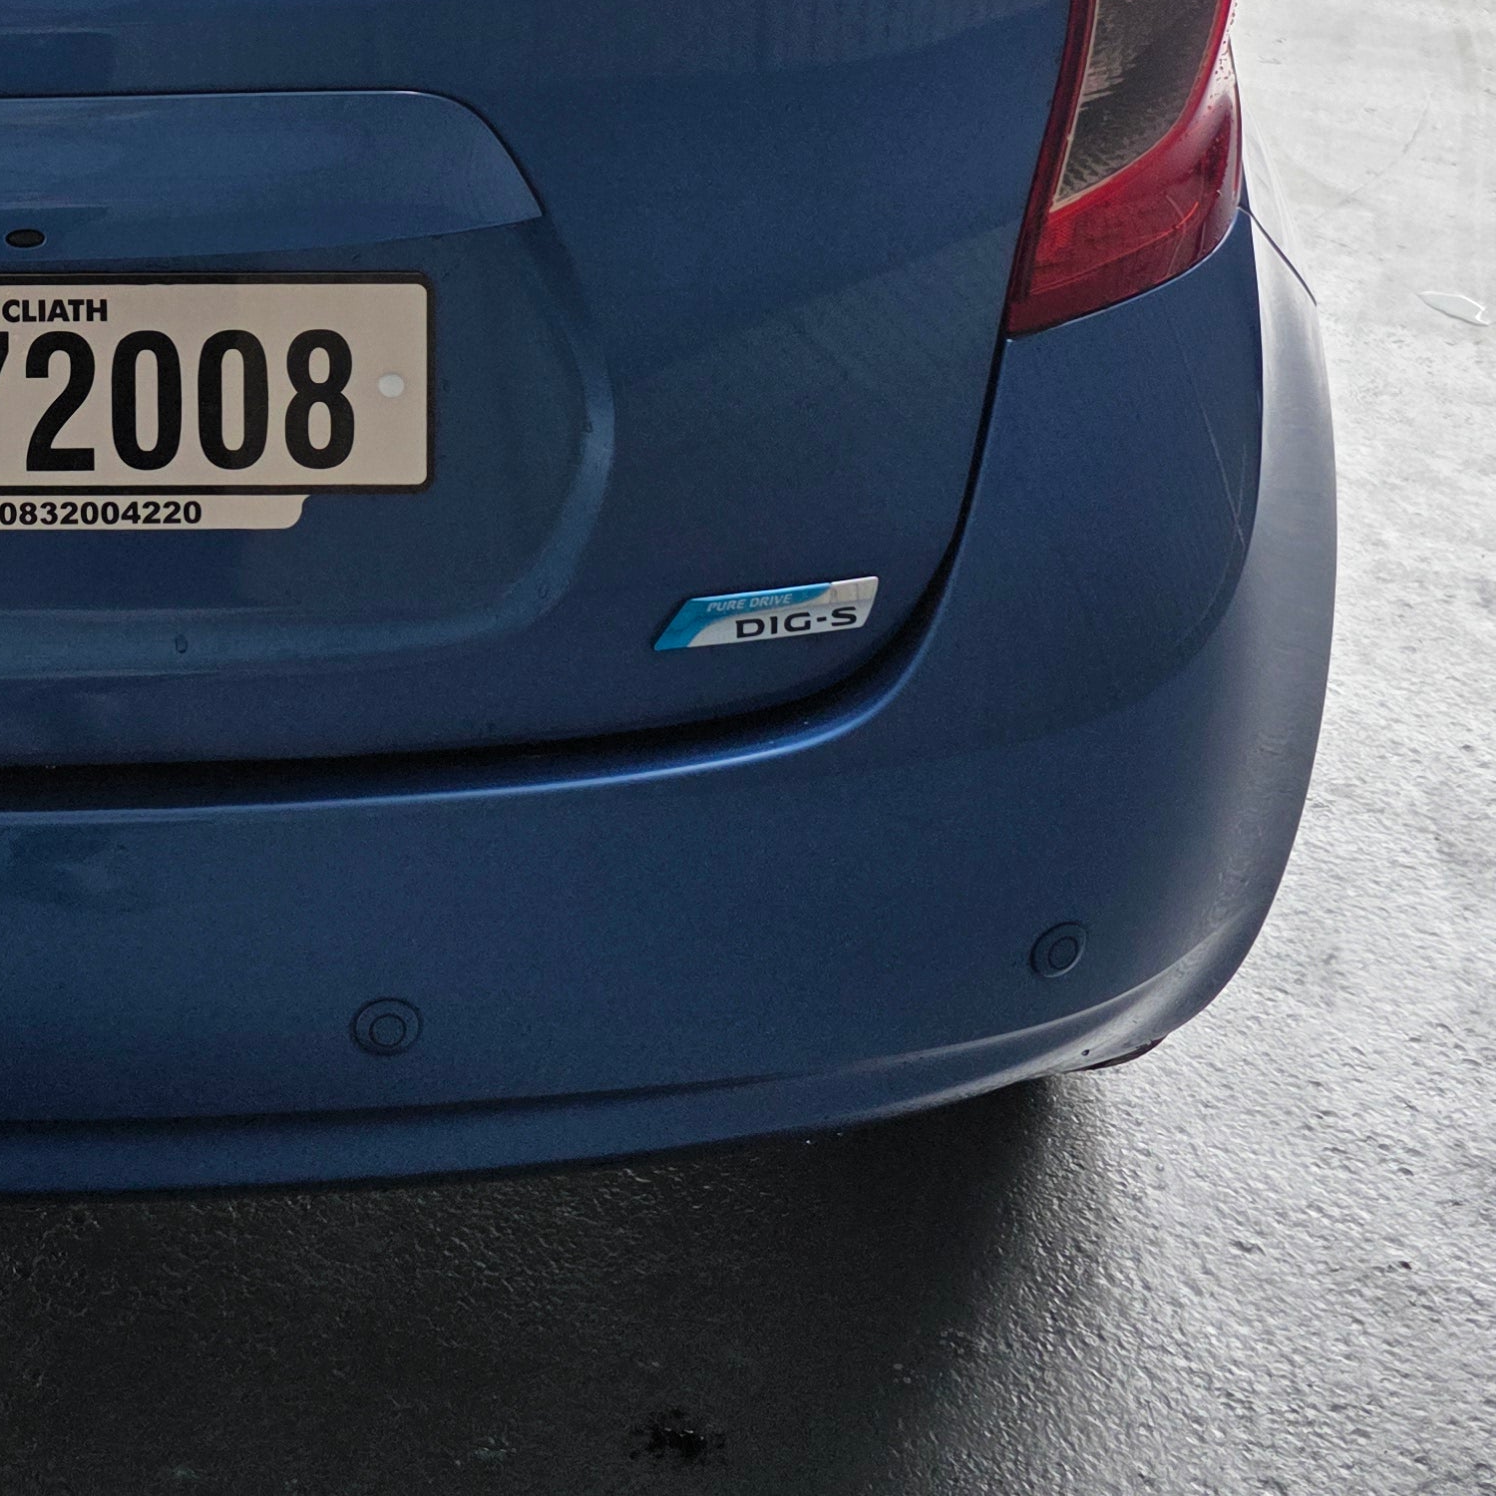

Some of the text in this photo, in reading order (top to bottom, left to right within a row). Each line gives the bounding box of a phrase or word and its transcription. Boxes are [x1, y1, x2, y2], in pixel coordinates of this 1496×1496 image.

[1, 298, 108, 324] CLIATH
[706, 592, 793, 613] PURE DRIVE
[735, 606, 858, 639] DIG-S
